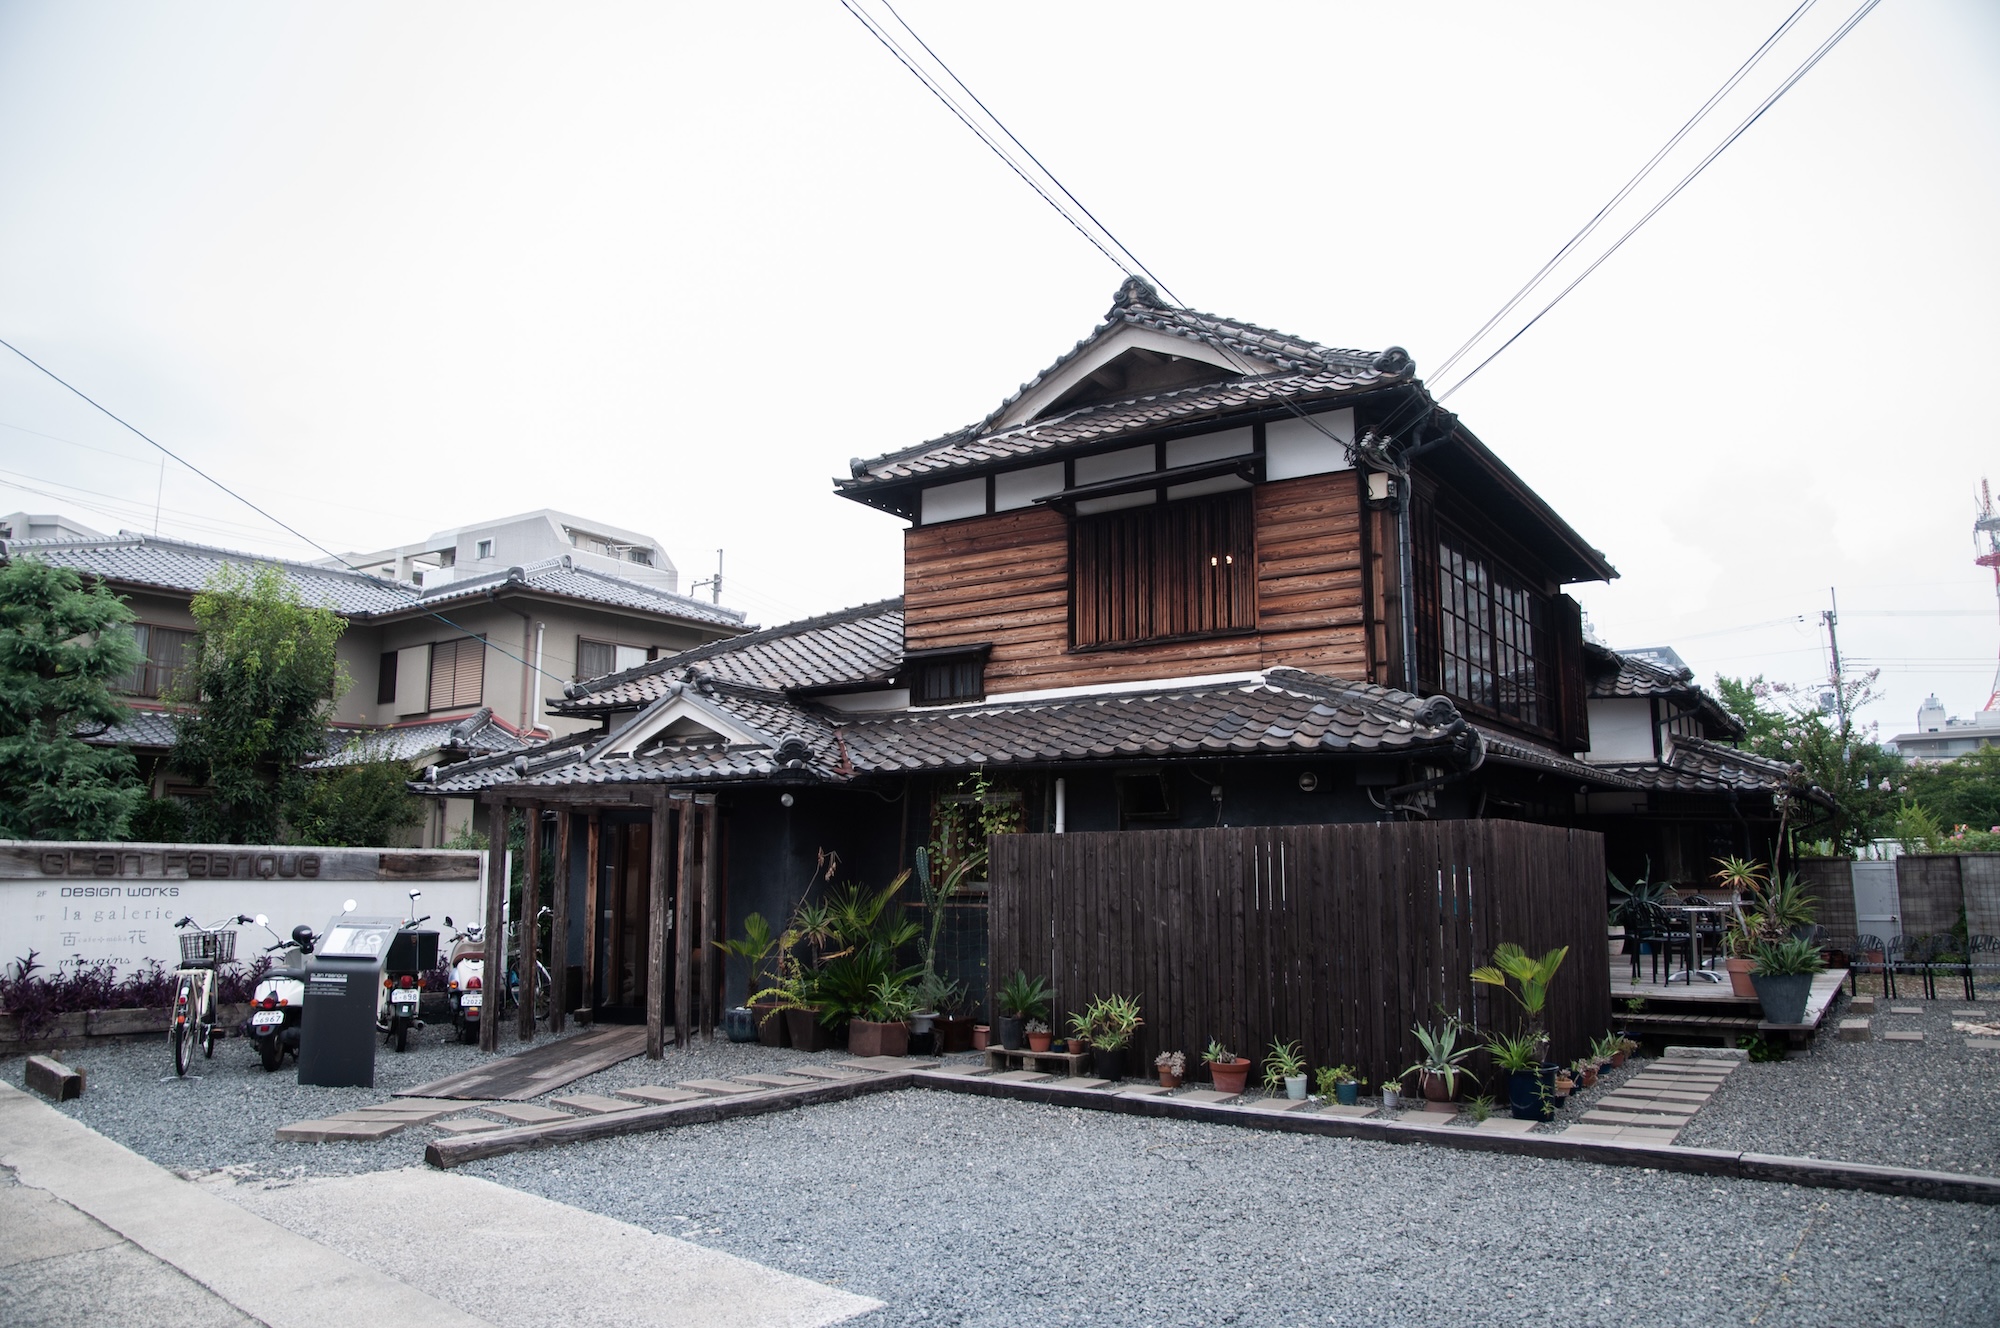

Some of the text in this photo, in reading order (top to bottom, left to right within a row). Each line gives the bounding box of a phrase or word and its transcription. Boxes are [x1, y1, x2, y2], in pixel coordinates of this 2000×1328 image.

[36, 890, 47, 898] 2F
[63, 906, 82, 921] la
[94, 905, 174, 922] galerie
[128, 930, 147, 944] 花
